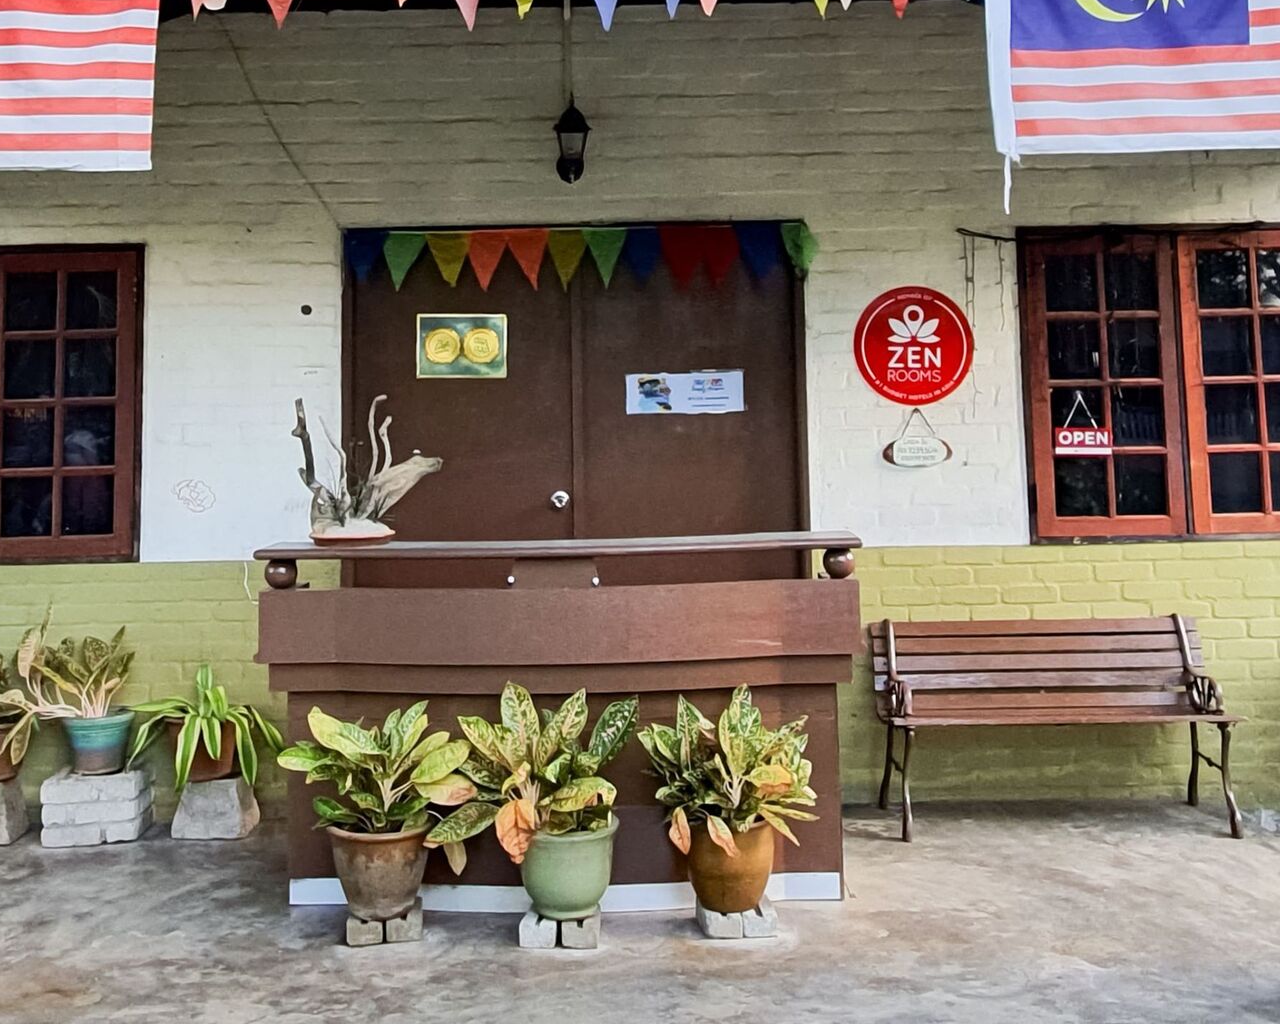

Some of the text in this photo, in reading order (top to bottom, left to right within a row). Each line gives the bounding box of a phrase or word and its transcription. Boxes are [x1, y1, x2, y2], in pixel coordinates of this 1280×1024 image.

[887, 346, 942, 368] ZEN
[887, 369, 942, 382] ROOMS
[1058, 431, 1108, 445] OPEN
